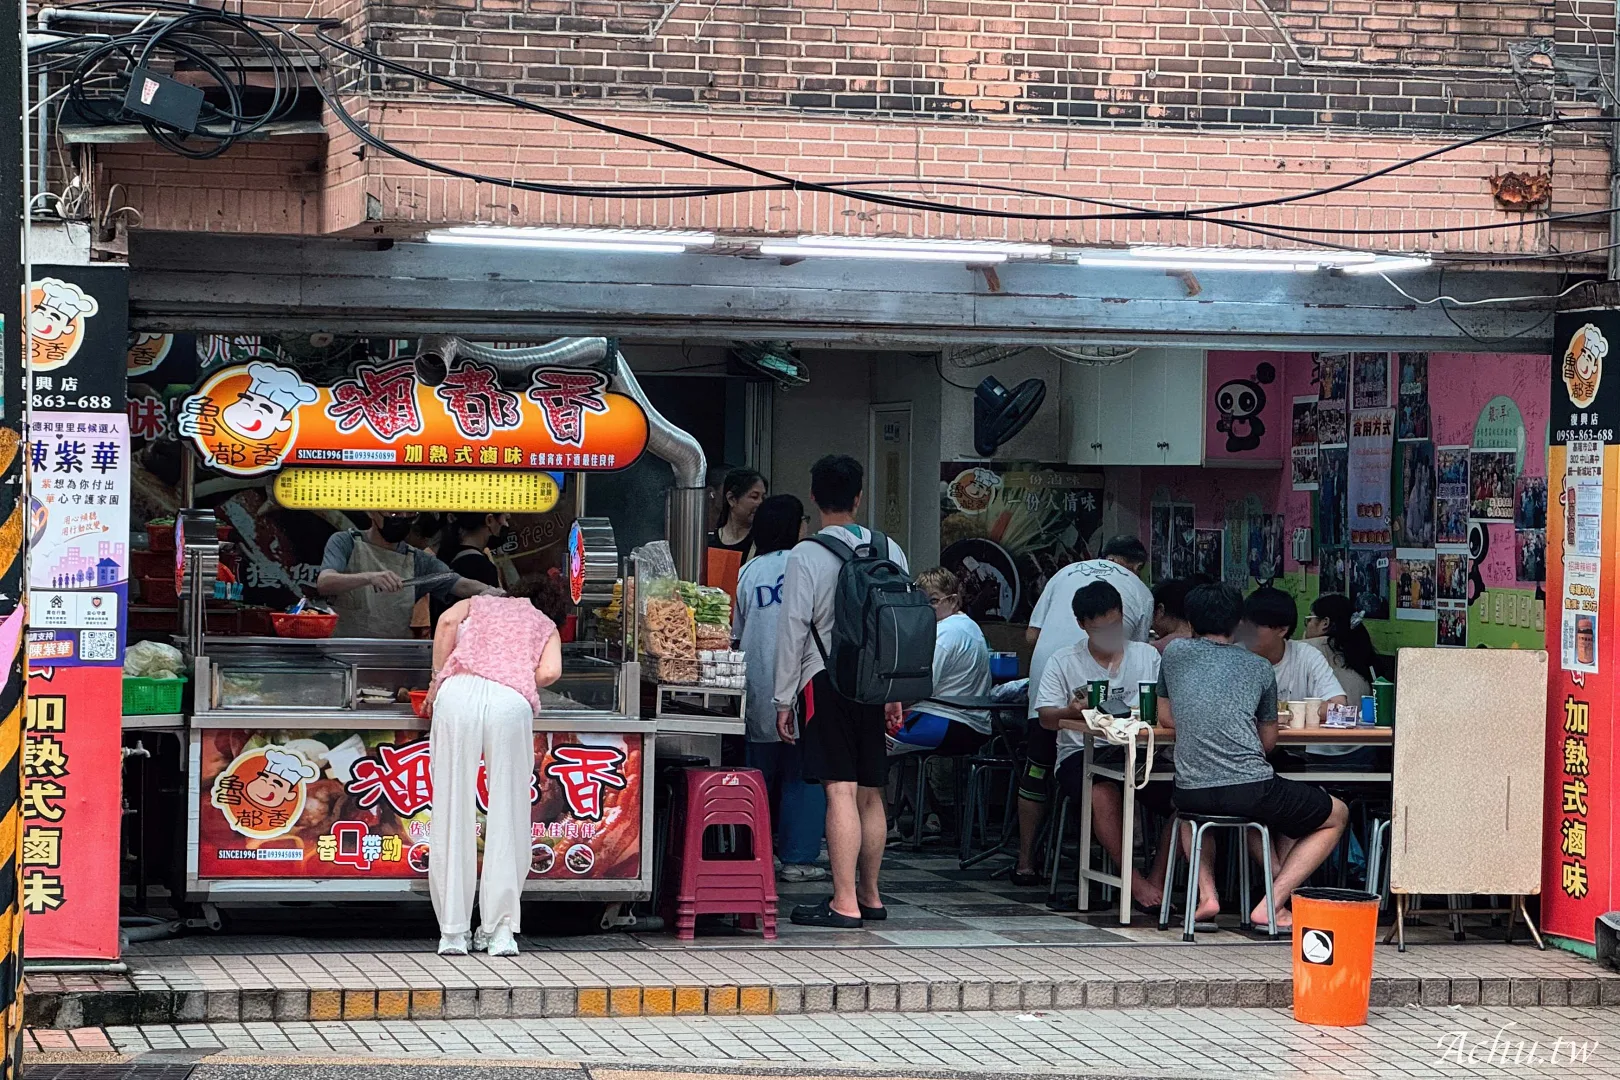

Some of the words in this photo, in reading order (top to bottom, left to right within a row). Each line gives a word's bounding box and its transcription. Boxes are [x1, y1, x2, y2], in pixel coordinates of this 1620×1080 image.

[1571, 381, 1595, 399] 都香
[1570, 413, 1599, 426] 復興店
[22, 421, 120, 434] 德和里里長候選人
[1353, 420, 1391, 437] 食用方式
[1556, 428, 1613, 442] 0958-863-688
[208, 442, 283, 467] 都香
[297, 449, 342, 460] SINCE1996
[354, 451, 395, 460] 0939450899
[404, 443, 524, 466] 加熱式滷味
[1570, 455, 1579, 464] 302
[1580, 454, 1600, 465] 中山高中
[41, 478, 115, 490] 紫想為你付出
[1009, 474, 1082, 486] 一份滷味
[45, 493, 120, 506] 華心守護家園
[1007, 491, 1097, 513] 一份人情味
[1562, 695, 1590, 899] 加熱式滷味
[236, 809, 290, 828] 都香
[531, 822, 597, 839] 最佳良伴
[218, 849, 256, 859] SINCE1996
[267, 850, 302, 859] 0939450899
